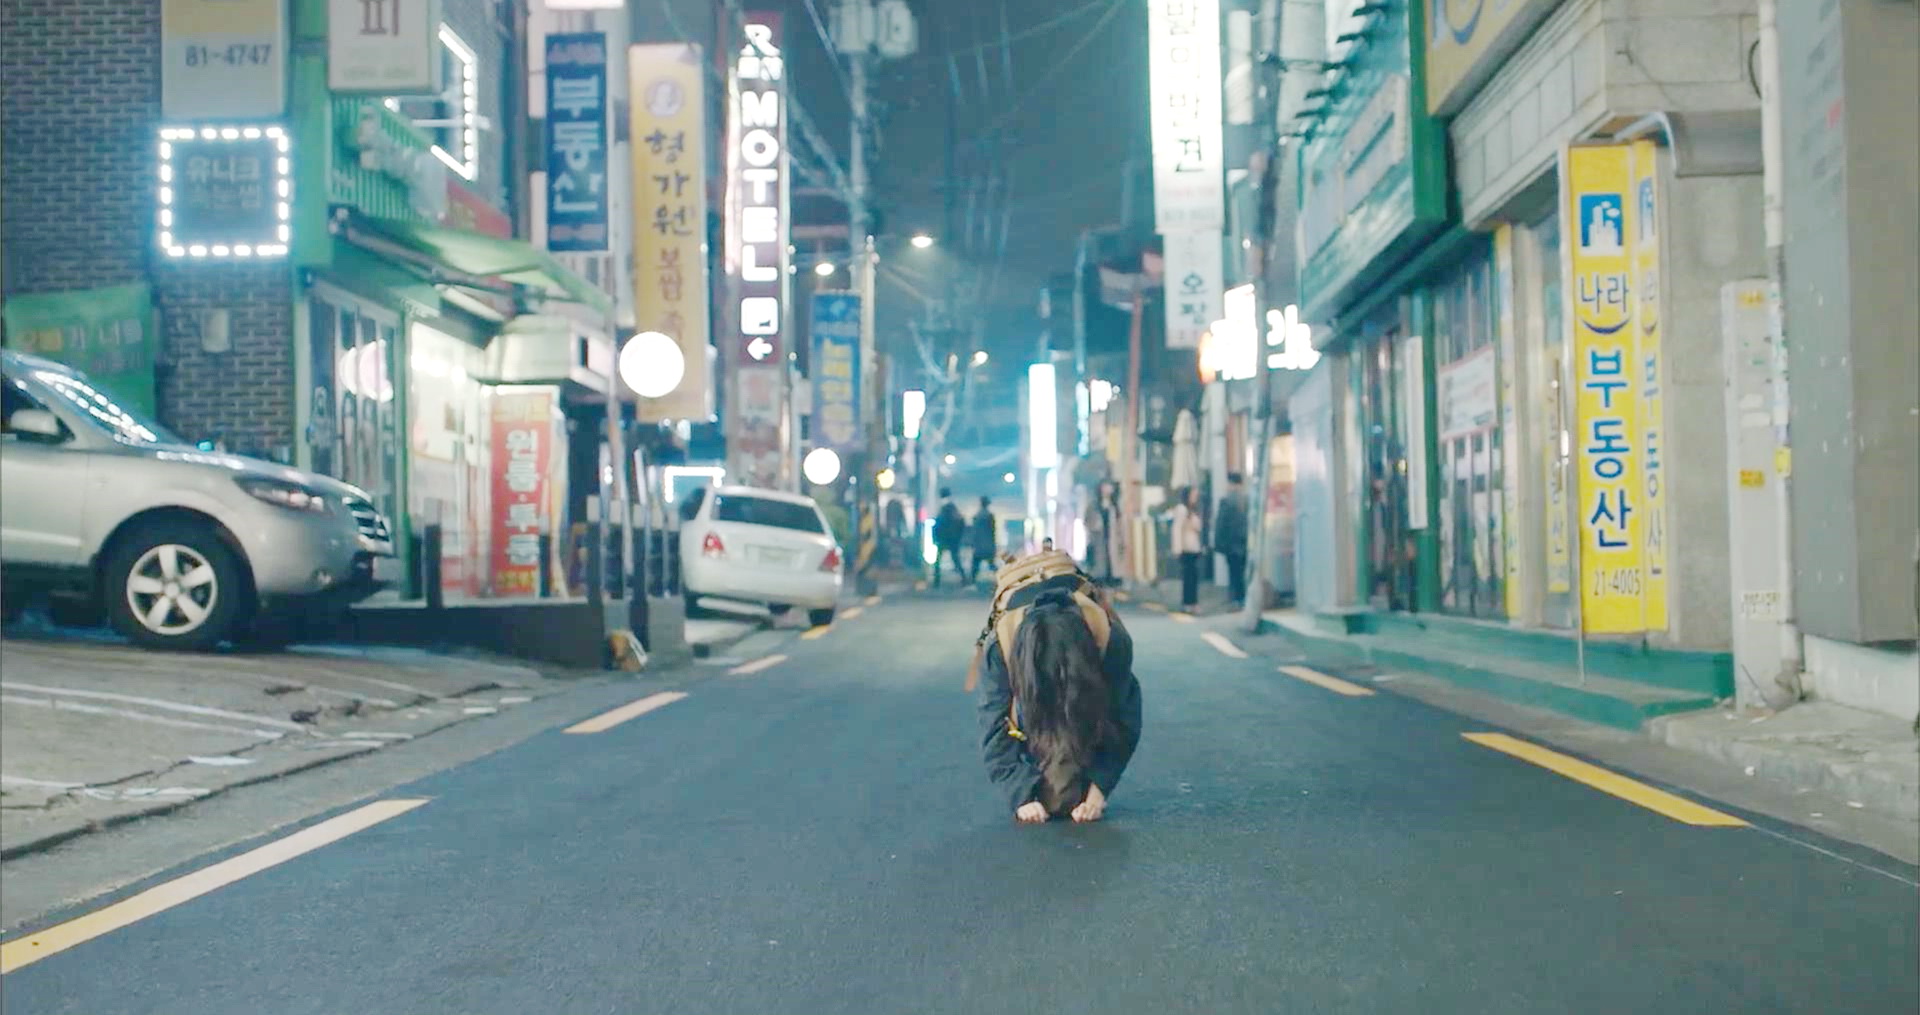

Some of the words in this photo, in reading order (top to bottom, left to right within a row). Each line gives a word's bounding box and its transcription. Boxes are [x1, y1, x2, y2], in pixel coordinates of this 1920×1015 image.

[185, 44, 271, 67] 81-4747
[552, 74, 602, 214] 부동산
[741, 91, 779, 281] MOTEL
[1580, 274, 1629, 314] 나라
[1585, 349, 1632, 548] 부동산
[1593, 568, 1641, 597] 21-4005
